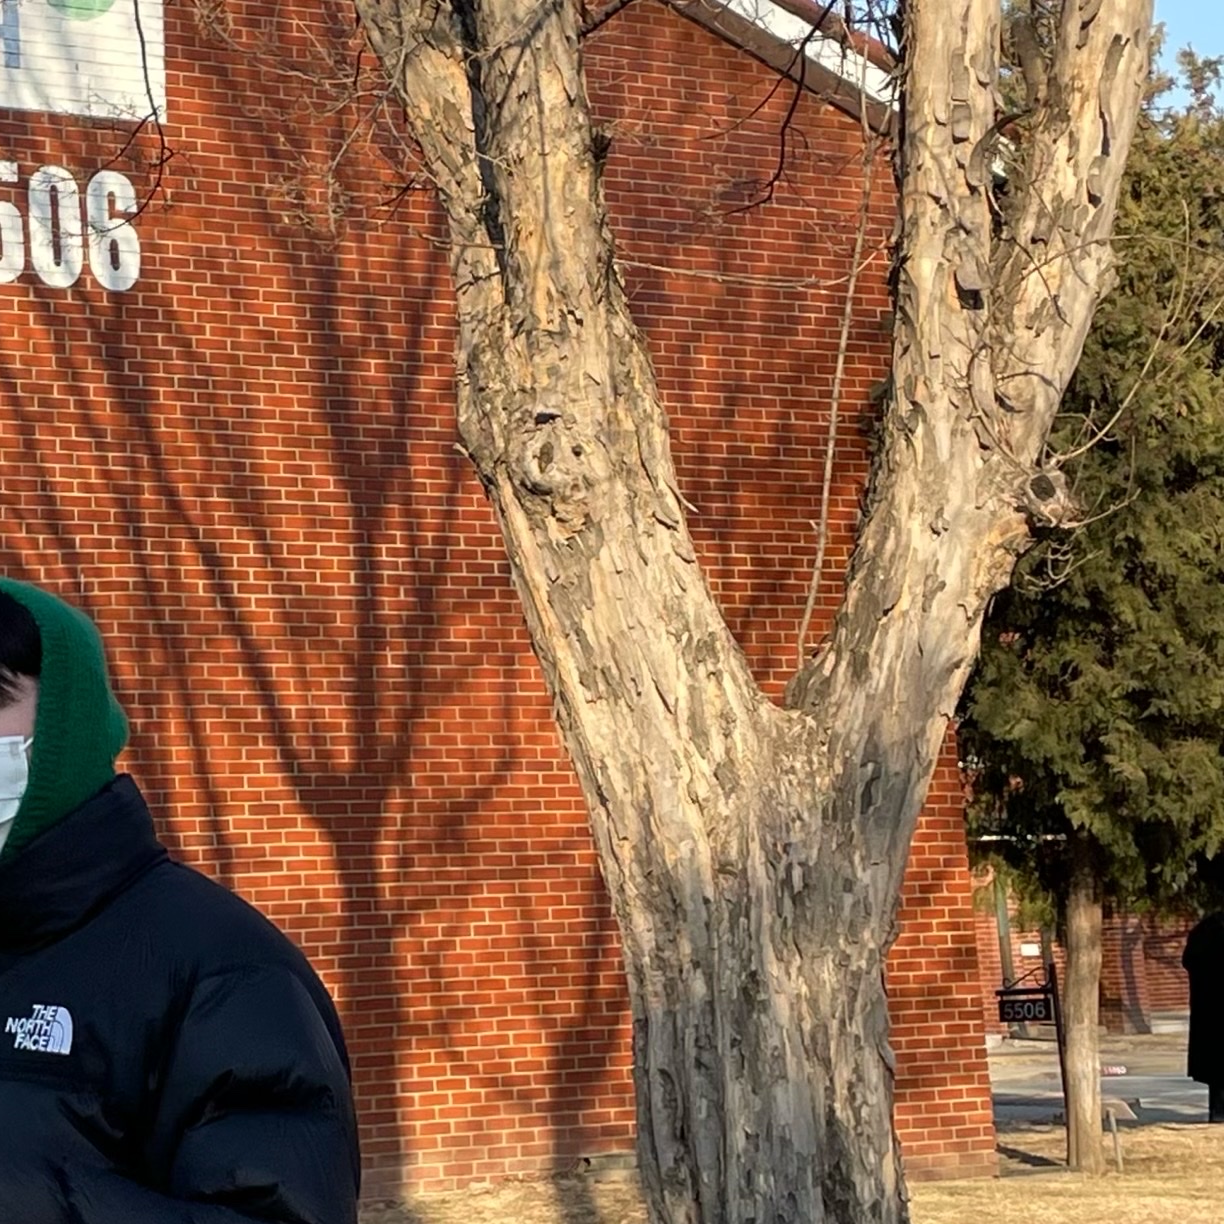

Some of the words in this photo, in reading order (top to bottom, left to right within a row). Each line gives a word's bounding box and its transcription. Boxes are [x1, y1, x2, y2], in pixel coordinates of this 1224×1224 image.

[32, 1004, 58, 1020] THE
[1003, 1002, 1046, 1019] 5506
[4, 1017, 54, 1036] NORTH
[13, 1033, 49, 1051] FACE
